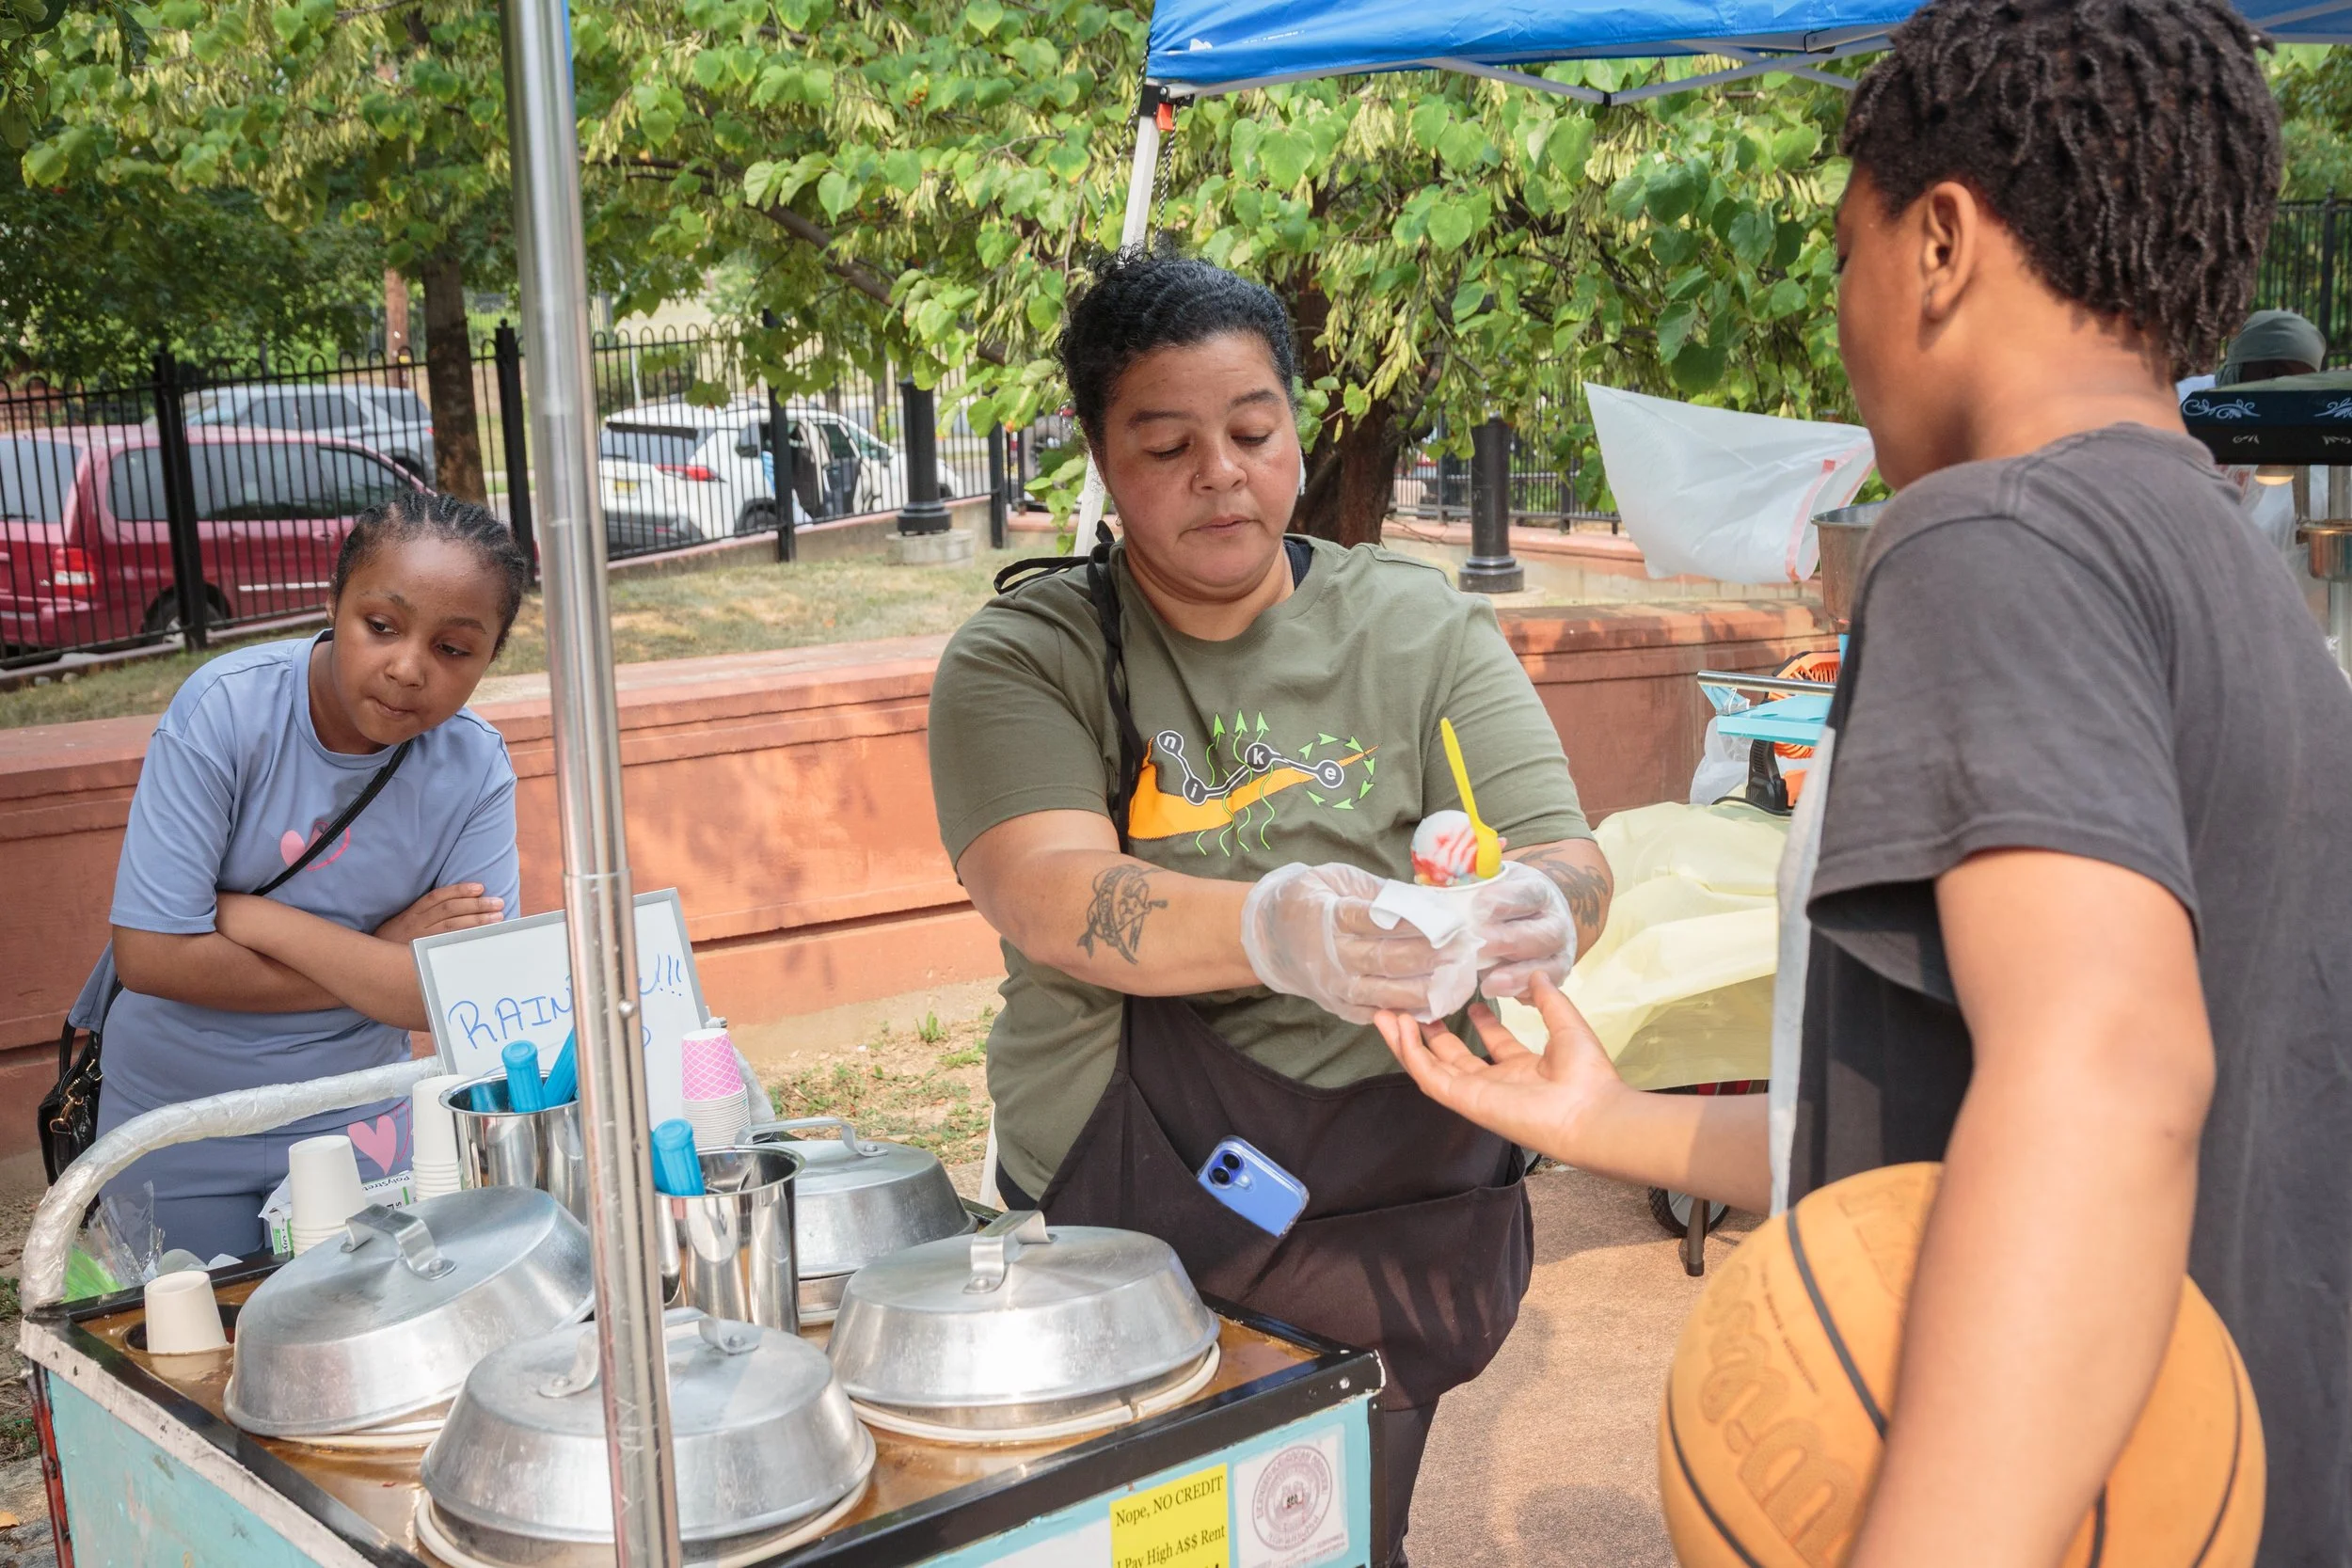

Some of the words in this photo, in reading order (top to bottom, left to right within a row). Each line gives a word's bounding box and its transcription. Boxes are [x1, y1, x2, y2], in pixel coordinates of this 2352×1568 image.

[362, 1176, 410, 1191] PolyStret
[1116, 1506, 1150, 1527] Nope,
[1153, 1493, 1172, 1513] NO
[1175, 1475, 1223, 1505] CREDIT
[1124, 1556, 1144, 1568] Pay
[1147, 1542, 1173, 1566] High
[1176, 1533, 1198, 1555] A$$
[1200, 1525, 1225, 1545] Rent
